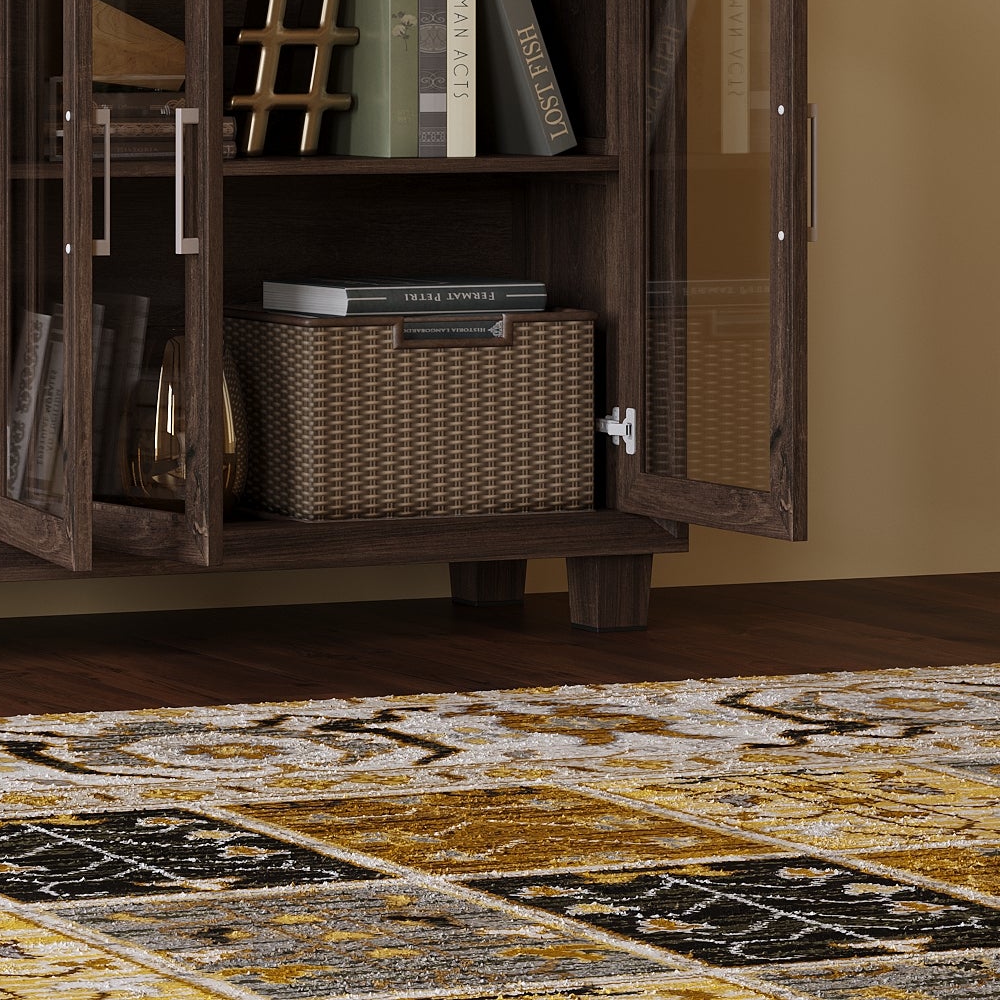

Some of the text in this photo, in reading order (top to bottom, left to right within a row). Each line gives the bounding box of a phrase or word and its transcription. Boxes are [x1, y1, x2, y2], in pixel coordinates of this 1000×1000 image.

[453, 49, 469, 99] ACTS
[516, 23, 568, 141] LOST FISH
[404, 291, 495, 302] FERMAT PETRI
